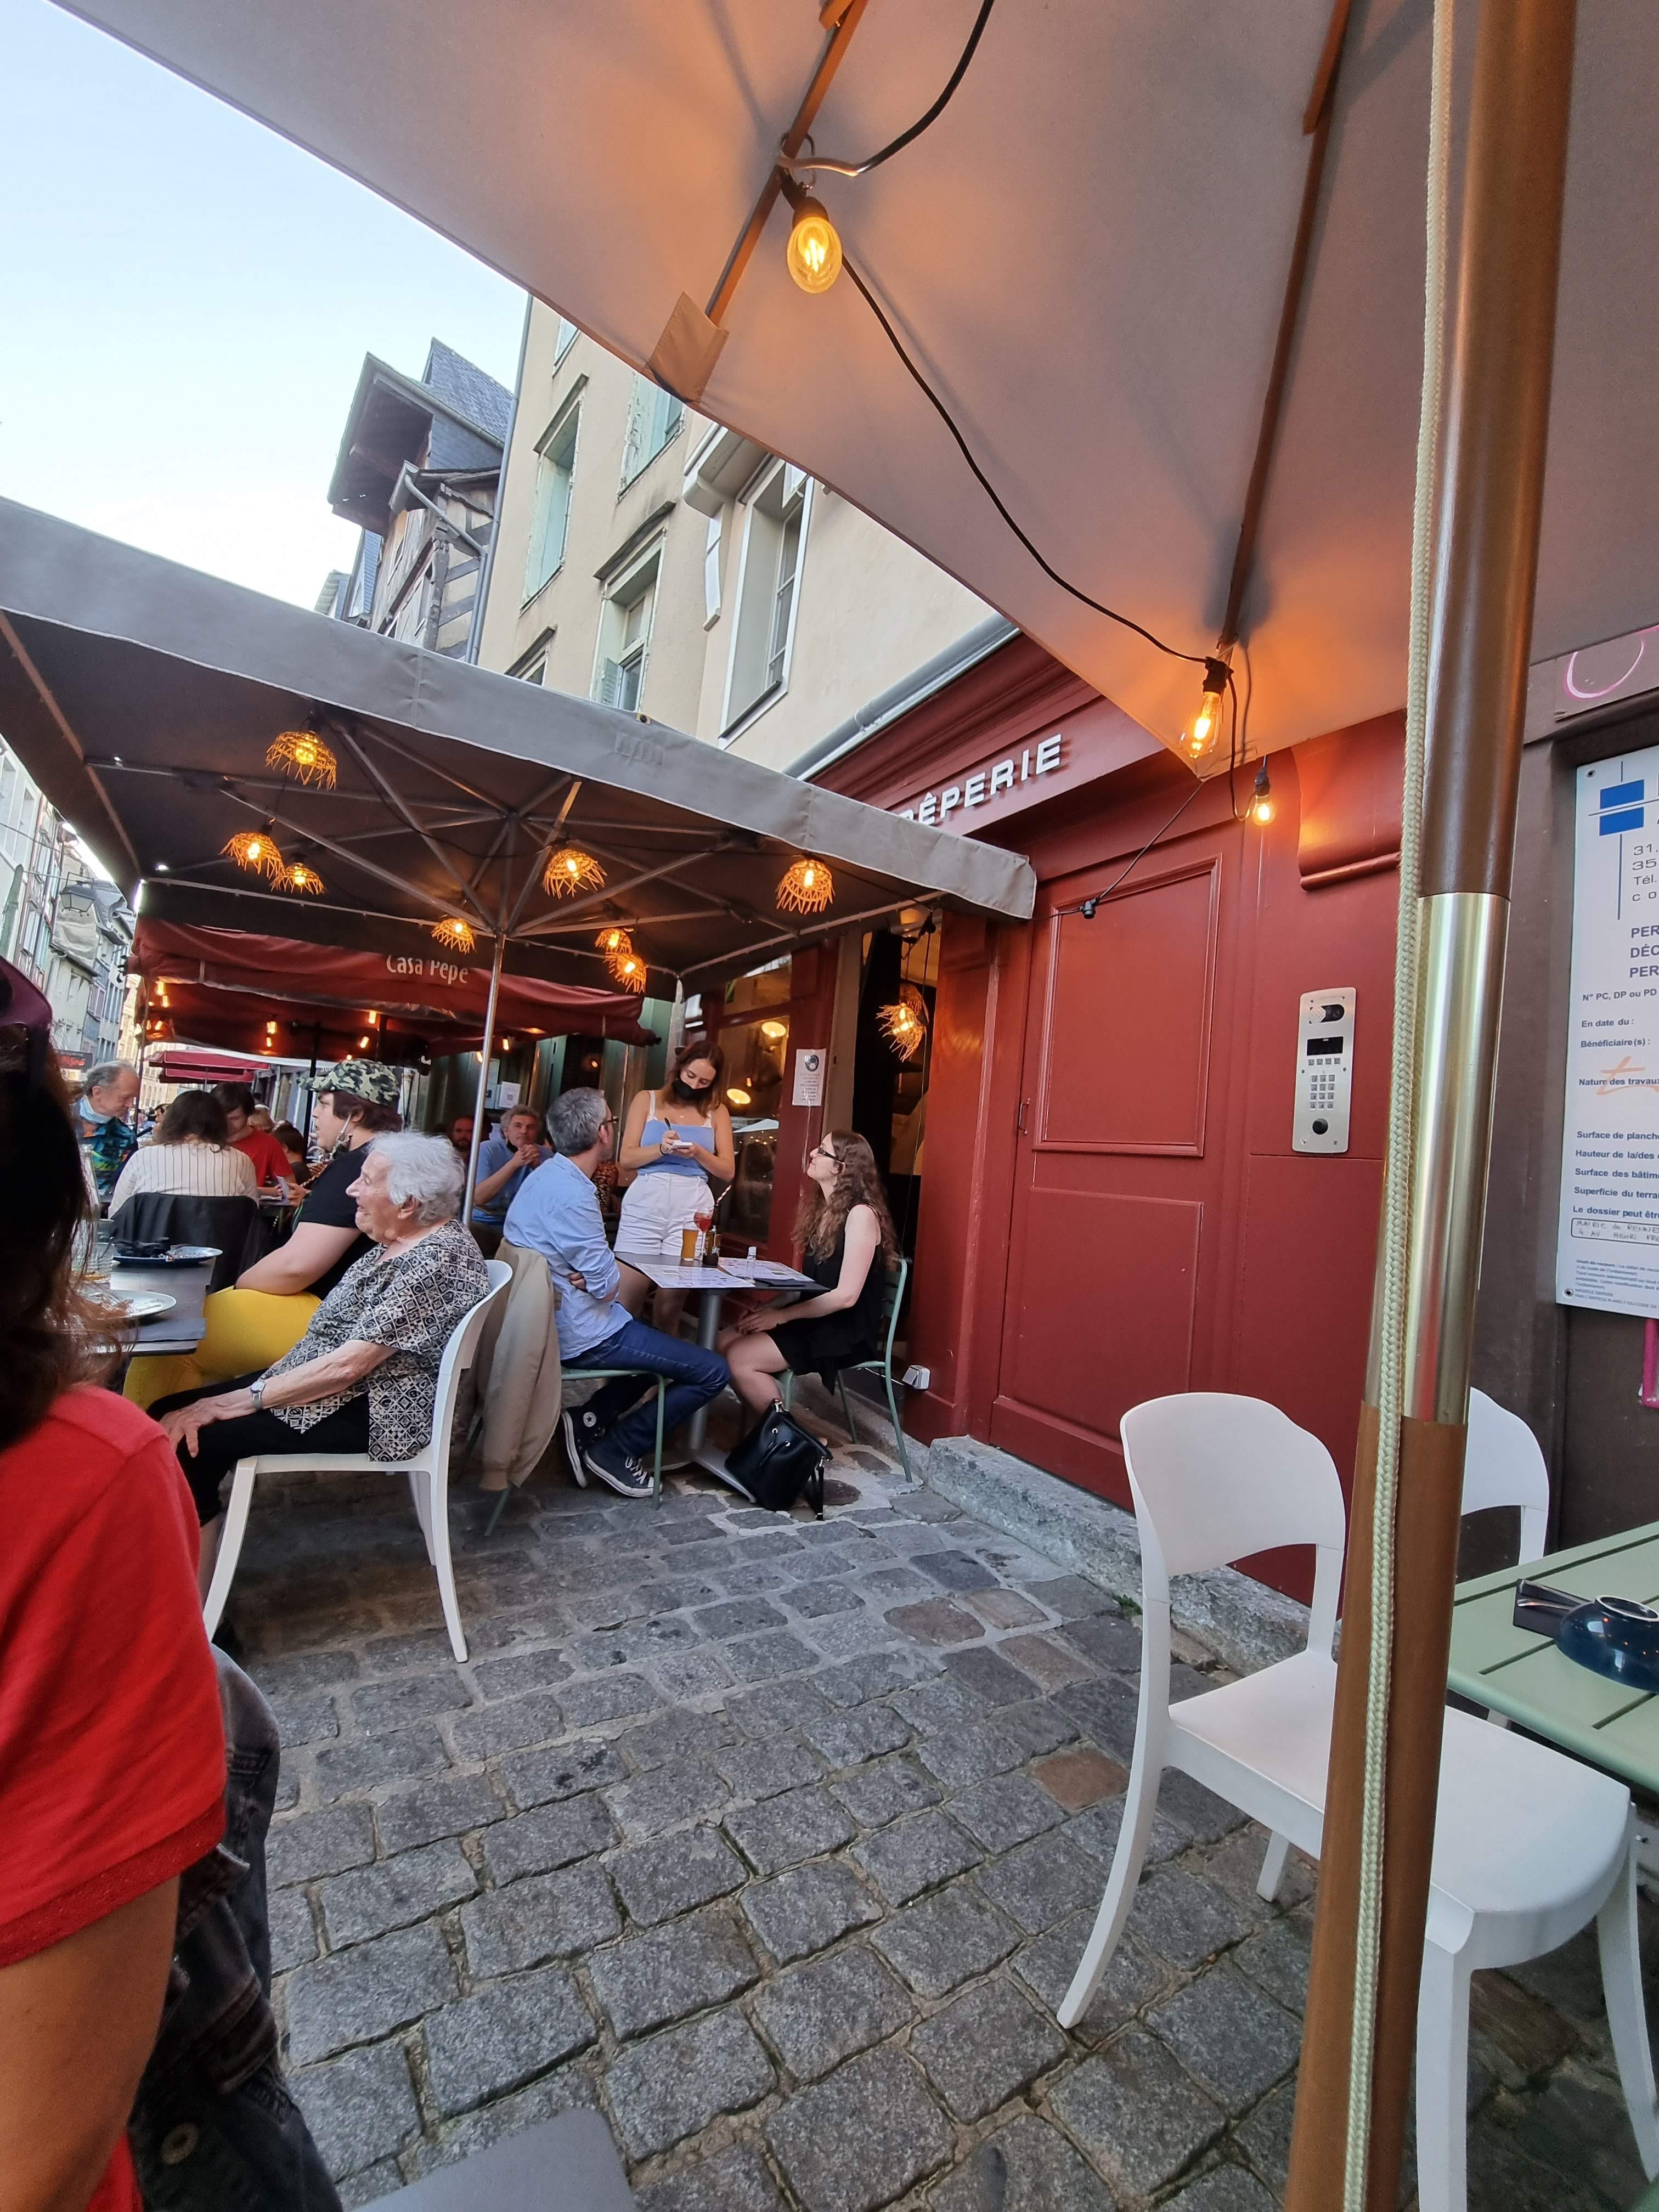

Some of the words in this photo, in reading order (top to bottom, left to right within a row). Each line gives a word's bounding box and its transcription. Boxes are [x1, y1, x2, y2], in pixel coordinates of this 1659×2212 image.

[1633, 859, 1659, 870] 35
[1633, 874, 1657, 885] Tél.
[1631, 925, 1659, 938] PER
[1630, 944, 1659, 958] DÉC
[1629, 966, 1659, 978] PER
[1575, 1168, 1608, 1177] Surface
[1574, 1187, 1618, 1196] Superficie
[1587, 1206, 1620, 1215] dossier
